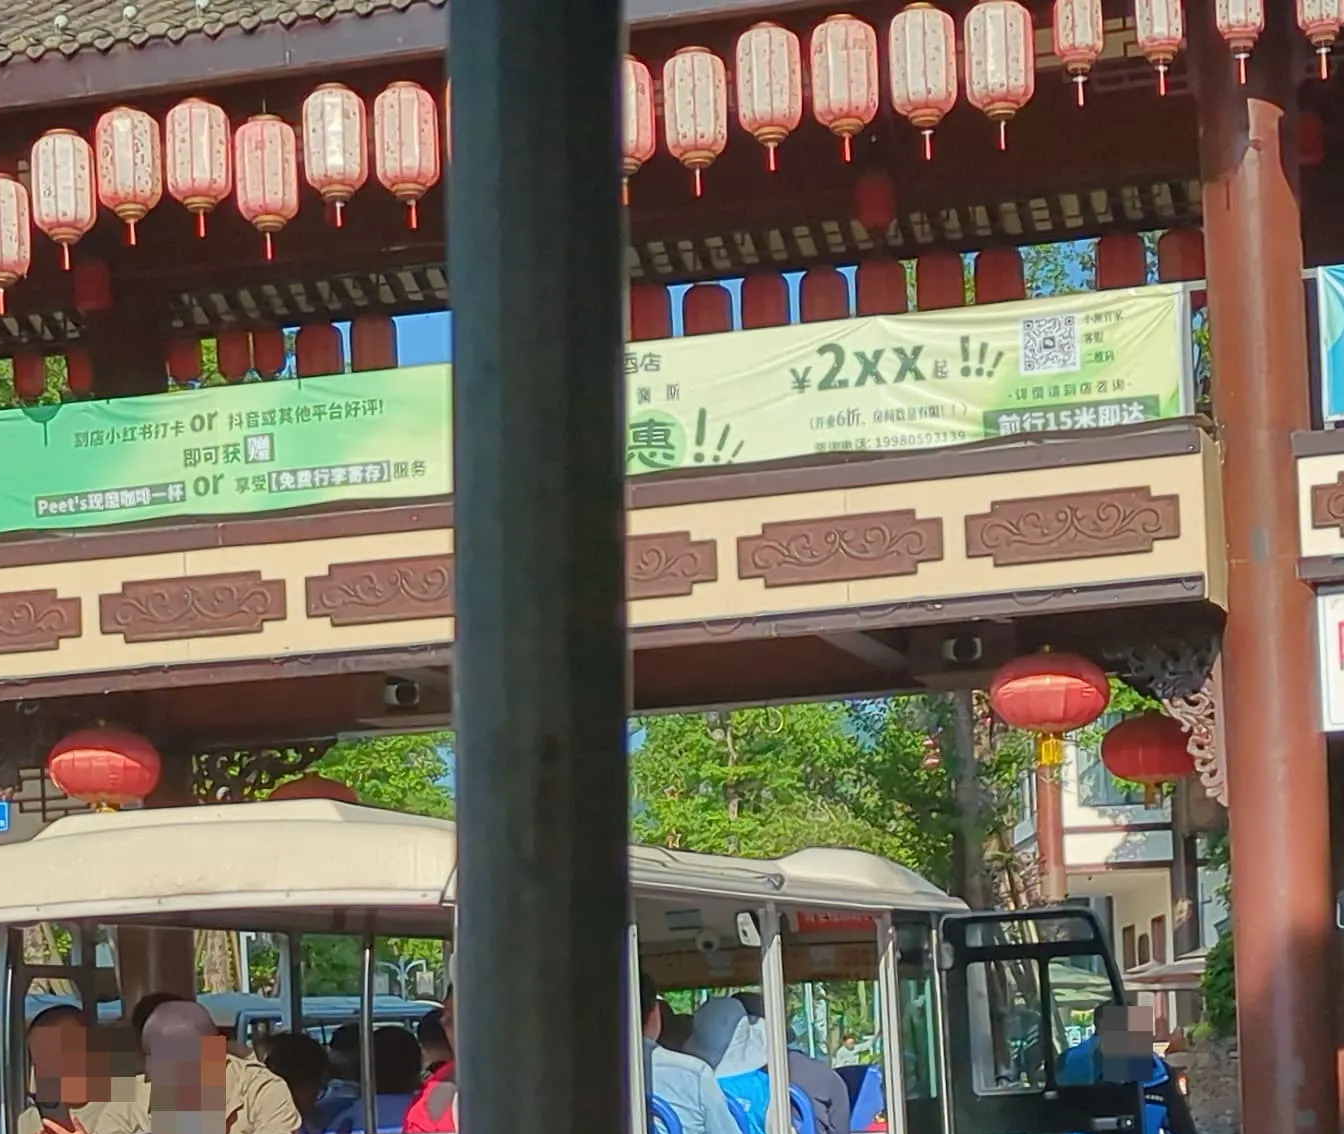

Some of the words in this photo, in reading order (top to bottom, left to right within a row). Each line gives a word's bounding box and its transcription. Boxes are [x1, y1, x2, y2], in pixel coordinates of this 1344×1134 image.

[74, 420, 185, 448] 到店小红书打卡
[190, 410, 219, 432] or
[193, 473, 225, 497] or
